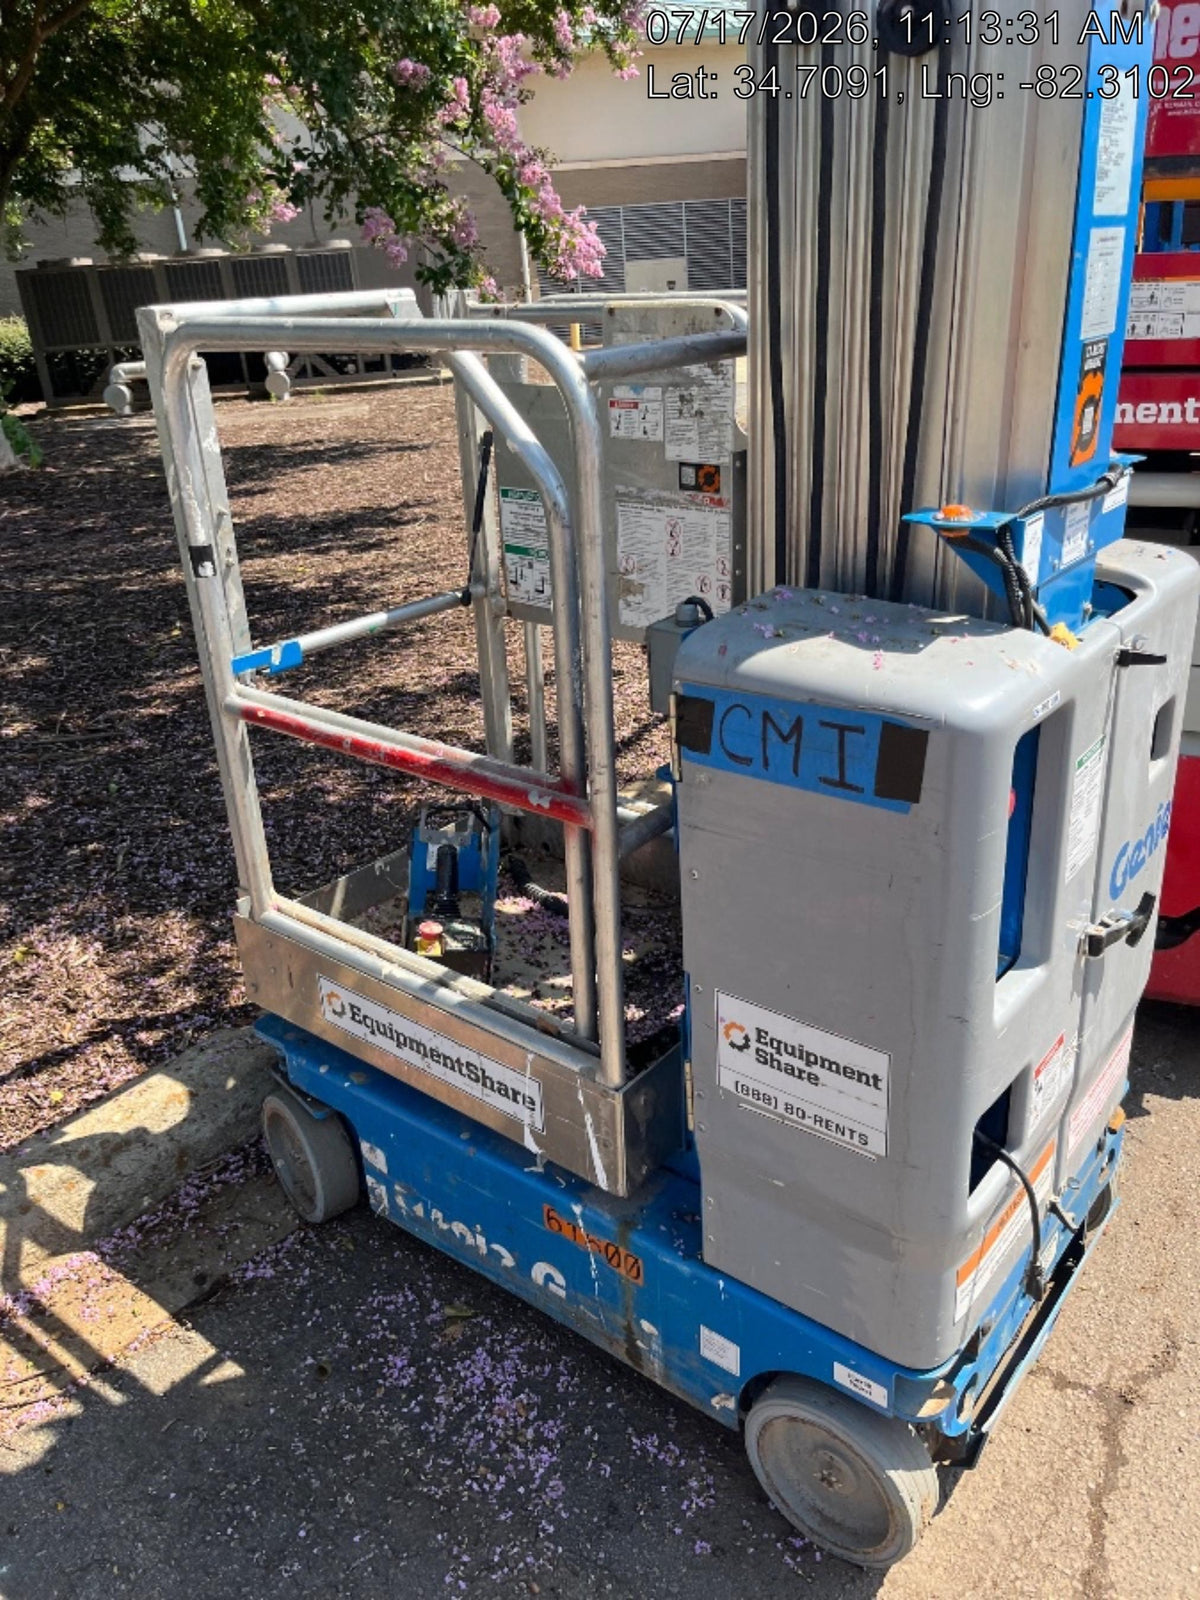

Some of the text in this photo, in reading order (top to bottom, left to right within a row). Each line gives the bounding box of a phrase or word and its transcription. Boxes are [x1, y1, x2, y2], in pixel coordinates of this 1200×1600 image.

[719, 704, 865, 793] CMI
[348, 1002, 537, 1112] EquipmentShare
[755, 1027, 882, 1091] Equipment
[755, 1047, 820, 1087] Share
[735, 1080, 869, 1146] (888) 80-RENTS
